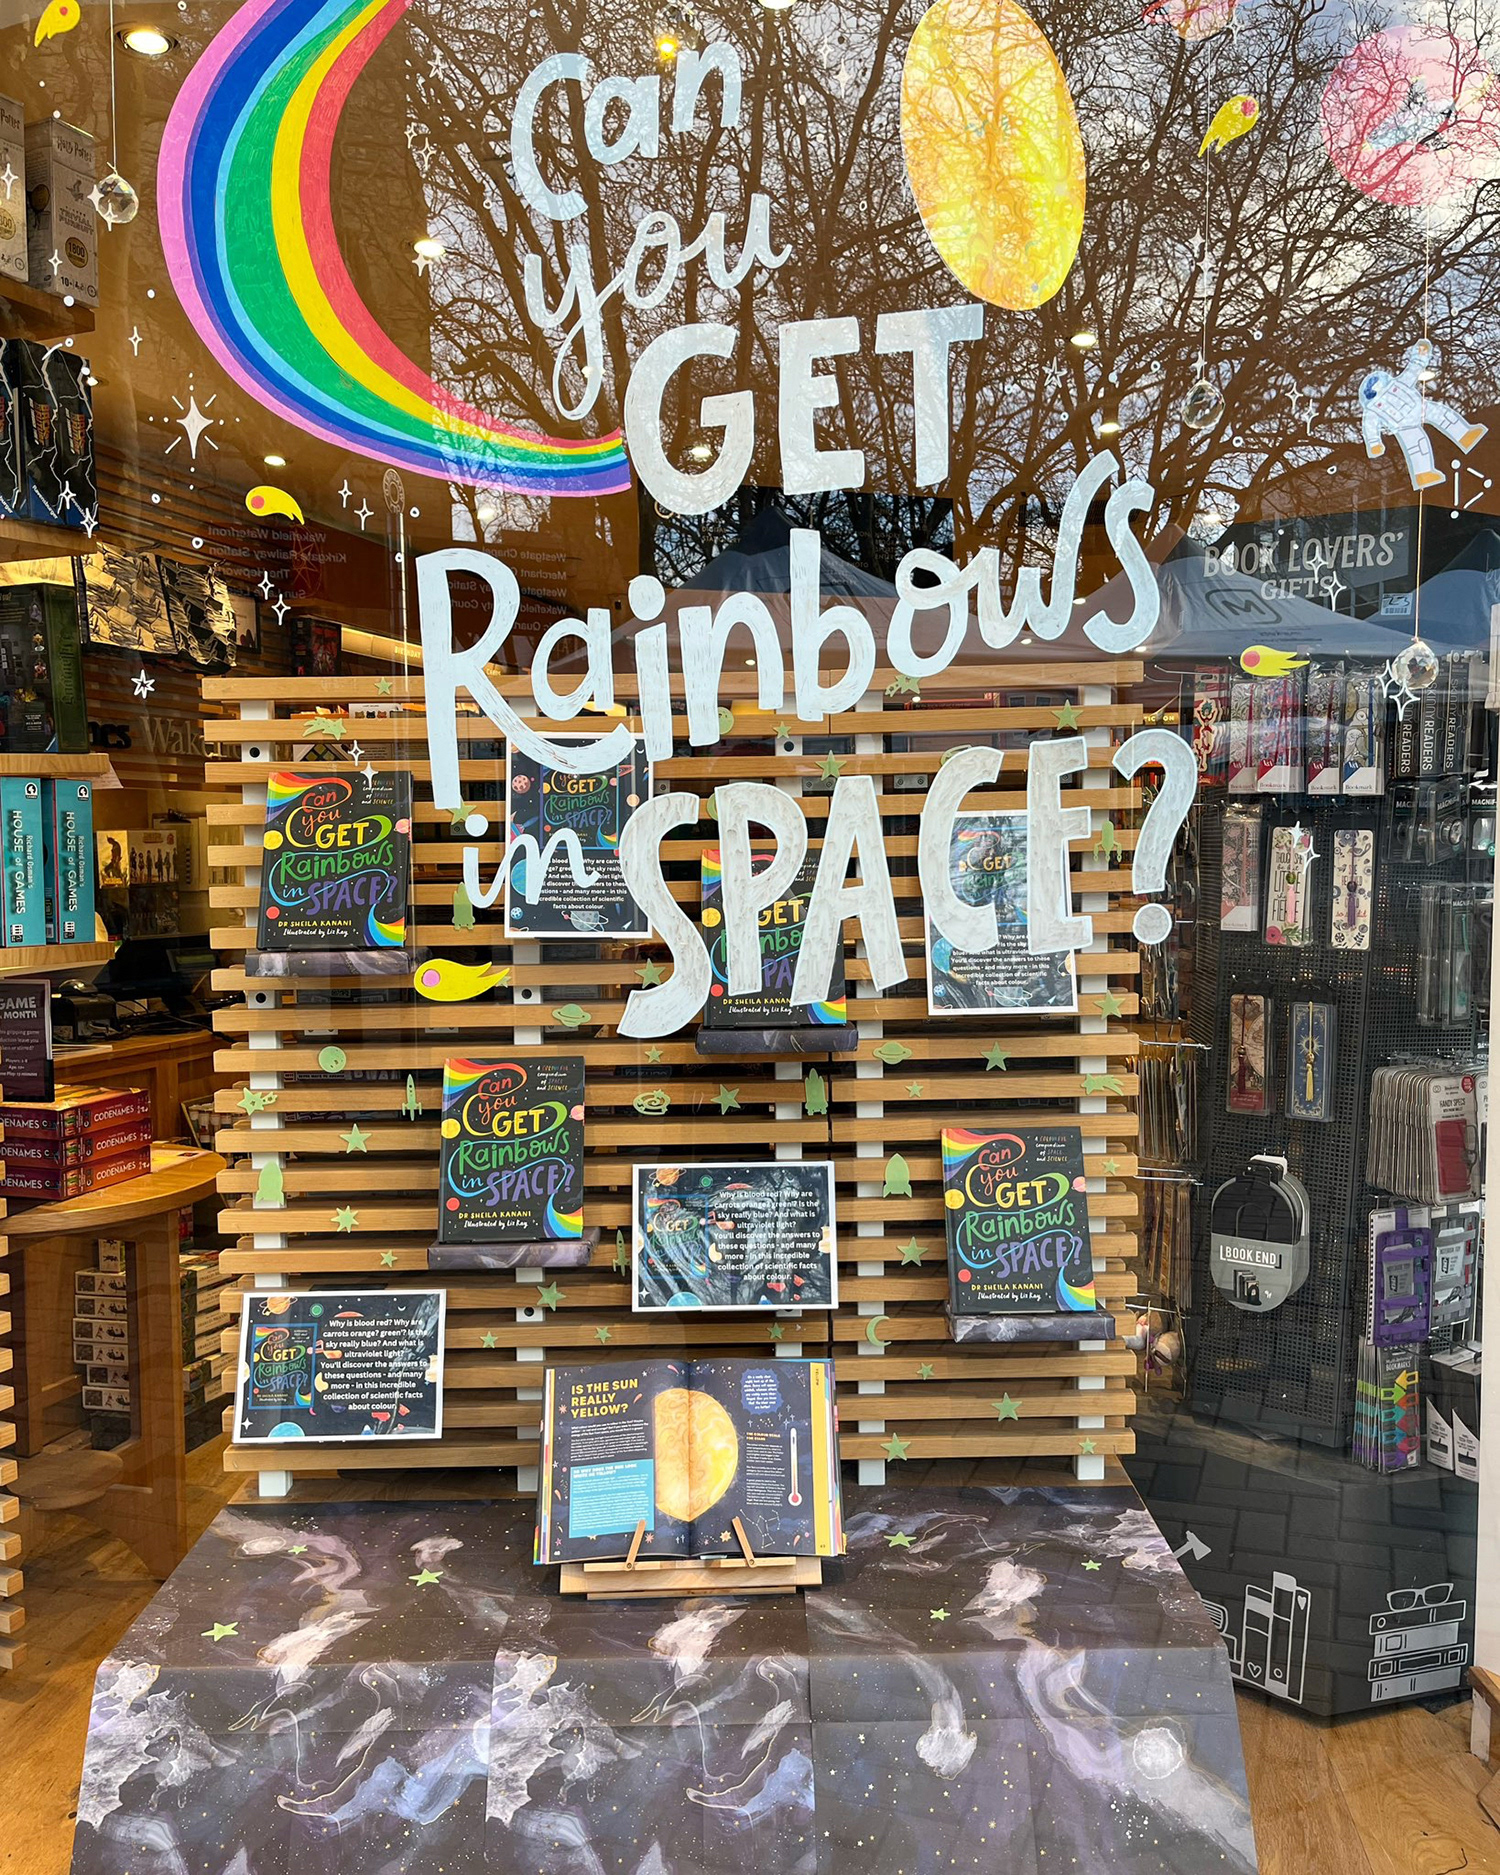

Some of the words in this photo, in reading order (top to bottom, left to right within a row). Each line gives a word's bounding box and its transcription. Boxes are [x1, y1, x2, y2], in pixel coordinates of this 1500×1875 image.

[511, 41, 742, 221] Can
[524, 193, 792, 421] you
[624, 304, 985, 516] GET
[1203, 541, 1278, 578] BOOK
[1261, 576, 1336, 601] GIFTS
[415, 450, 1161, 810] Rainbows
[1401, 724, 1412, 773] READERS
[1423, 720, 1434, 770] READERS
[1446, 717, 1456, 768] READERS
[567, 779, 595, 793] GET
[302, 791, 336, 813] Can
[13, 810, 23, 852] HOUSE
[66, 811, 76, 852] HOUSE
[302, 810, 341, 837] you
[316, 822, 369, 848] GET
[15, 857, 22, 866] of
[68, 857, 74, 866] of
[281, 841, 393, 885] Rainbows
[462, 813, 601, 910] in
[15, 871, 26, 914] GAMES
[68, 869, 78, 912] GAMES
[283, 885, 304, 898] in
[306, 876, 398, 915] SPACE?
[617, 727, 1199, 1039] SPACE?
[318, 929, 326, 938] by
[4, 1011, 37, 1019] MONTH
[763, 1007, 769, 1015] by
[478, 1078, 512, 1100] Can
[94, 1104, 134, 1122] CODENAMES
[479, 1096, 517, 1125] you
[492, 1109, 545, 1137] GET
[96, 1132, 137, 1150] CODENAMES
[459, 1127, 570, 1175] Rainbows
[96, 1161, 136, 1180] CODENAMES
[978, 1148, 1011, 1171] Can
[462, 1175, 483, 1189] in
[486, 1164, 575, 1207] SPACE?
[981, 1166, 1018, 1196] you
[996, 1181, 1047, 1208] GET
[499, 1221, 505, 1230] by
[500, 1210, 531, 1218] KANANI
[966, 1199, 1075, 1246] Rainbows
[972, 1247, 992, 1260] in
[996, 1236, 1083, 1278] SPACE?
[1225, 1245, 1253, 1262] BOOK
[1256, 1250, 1277, 1266] END
[1012, 1293, 1019, 1302] by
[329, 1320, 345, 1328] Why
[394, 1319, 409, 1328] Why
[350, 1330, 379, 1339] orange?
[273, 1348, 296, 1362] GET
[326, 1340, 338, 1349] sky
[339, 1340, 360, 1349] really
[344, 1350, 382, 1358] ultraviolet
[384, 1350, 404, 1358] light?
[346, 1371, 381, 1380] questions
[402, 1372, 423, 1380] many
[572, 1384, 584, 1395] IS
[586, 1382, 610, 1393] THE
[613, 1378, 638, 1391] SUN
[323, 1392, 359, 1400] collection
[571, 1393, 616, 1406] REALLY
[571, 1403, 628, 1419] YELLOW?
